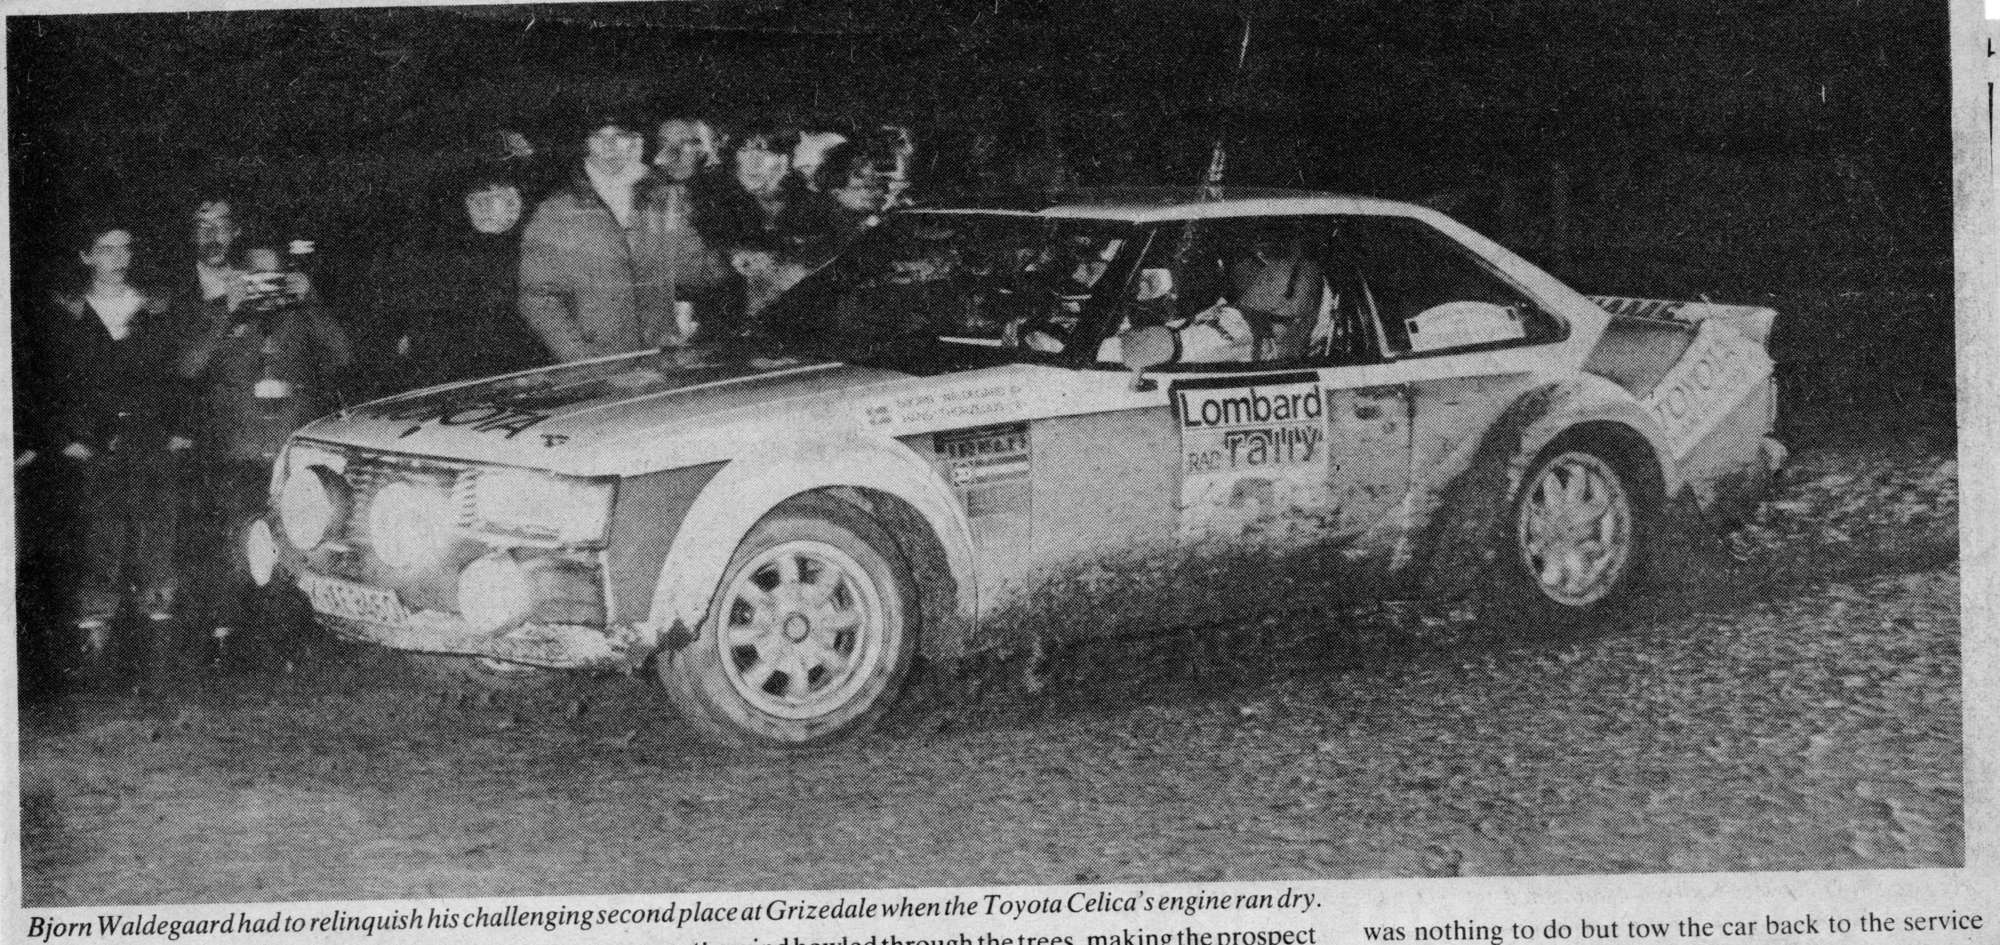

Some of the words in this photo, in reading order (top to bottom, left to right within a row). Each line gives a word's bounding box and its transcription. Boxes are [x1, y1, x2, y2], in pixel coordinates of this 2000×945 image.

[1180, 385, 1322, 427] Lombard
[1189, 450, 1222, 473] RAC
[1224, 425, 1324, 468] rally
[27, 917, 92, 944] Bjorn
[98, 912, 235, 941] Waldegaard
[237, 911, 282, 934] had
[284, 917, 306, 933] to
[310, 908, 423, 937] relinquish
[427, 909, 460, 929] his
[463, 905, 594, 932] challenging
[596, 902, 676, 925] second
[677, 902, 738, 929] place
[740, 905, 763, 921] at
[766, 897, 878, 921] Grizedale
[881, 896, 940, 917] when
[944, 896, 979, 916] the
[984, 895, 1063, 921] Toyota
[1067, 890, 1154, 913] Celica's
[1158, 890, 1232, 916] engine
[1235, 895, 1274, 910] ran
[1277, 888, 1322, 914] dry.
[1087, 929, 1173, 945] making
[1178, 927, 1212, 945] the
[1217, 928, 1316, 945] prospect
[1363, 928, 1406, 941] was
[1415, 920, 1503, 945] nothing
[1512, 924, 1535, 939] to
[1543, 918, 1573, 939] do
[1581, 919, 1619, 939] but
[1628, 923, 1670, 938] tow
[1678, 917, 1715, 937] the
[1722, 922, 1757, 937] car
[1766, 914, 1819, 935] back
[1828, 917, 1852, 934] to
[1860, 912, 1896, 933] the
[1903, 915, 1984, 931] service
